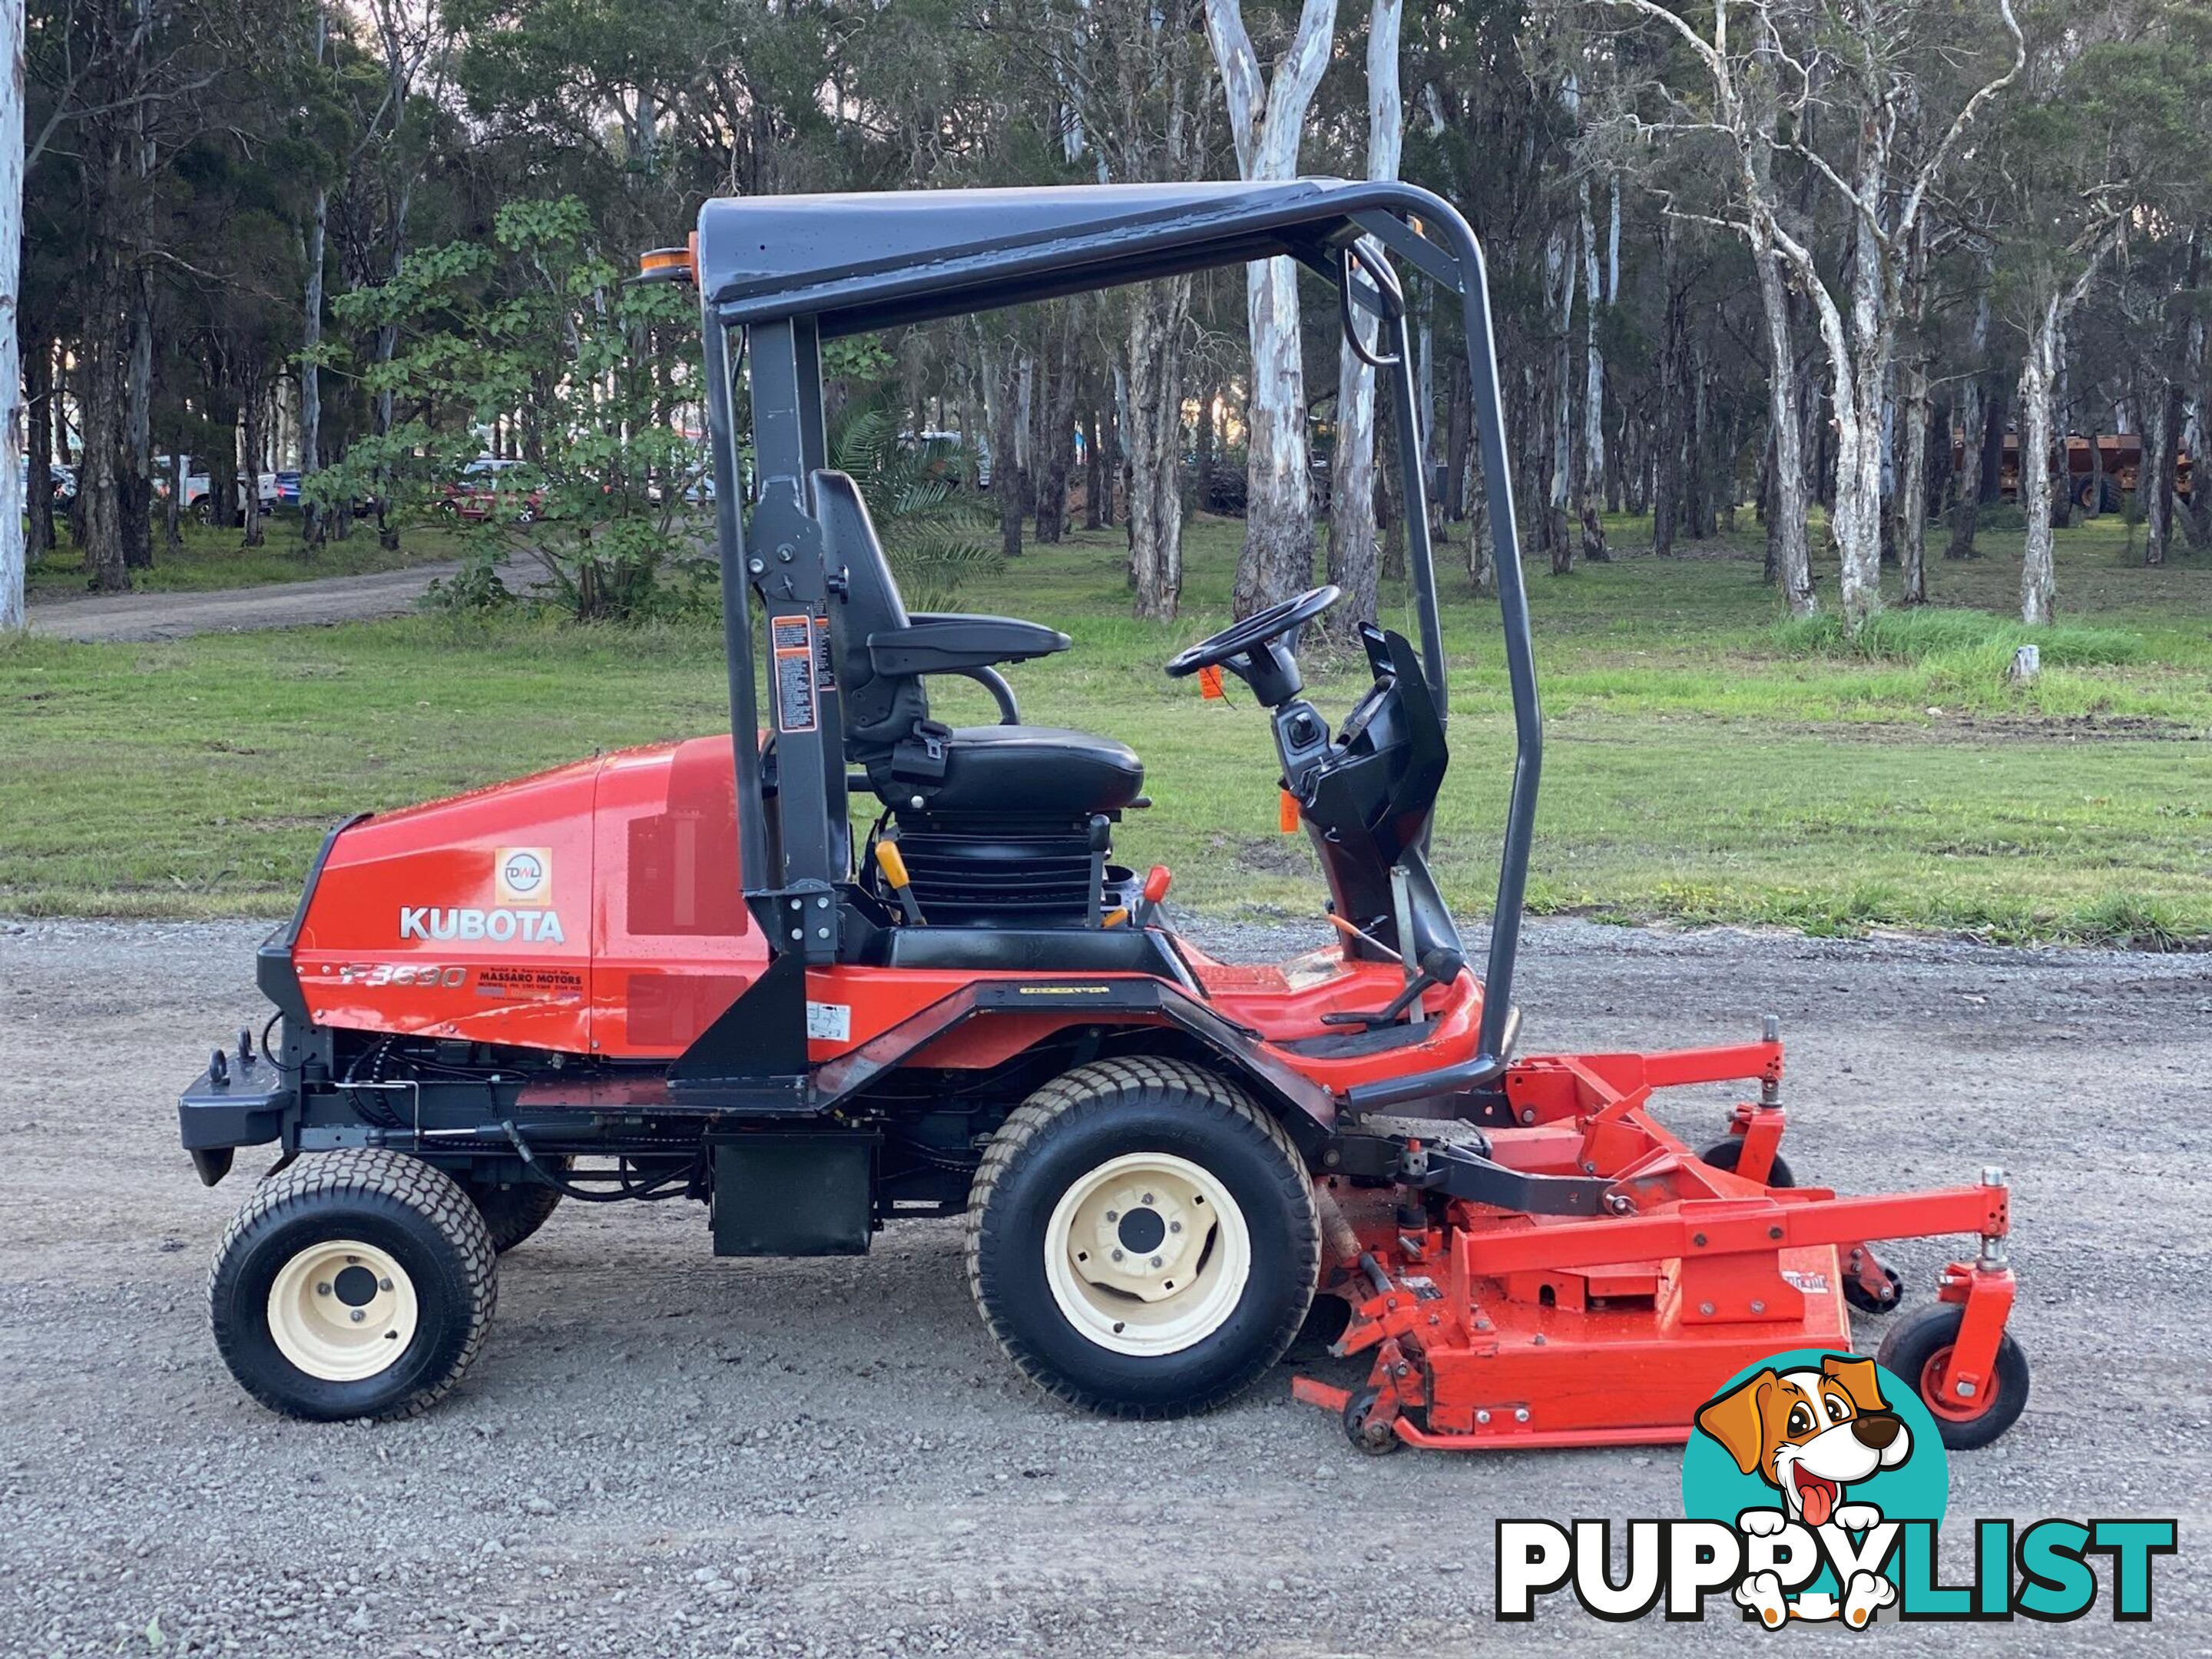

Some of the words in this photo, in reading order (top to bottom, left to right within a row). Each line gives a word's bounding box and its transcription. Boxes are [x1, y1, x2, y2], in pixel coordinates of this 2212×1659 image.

[400, 906, 565, 942] KUBOTA
[343, 963, 467, 988] F3690
[479, 972, 533, 982] MASSARO
[536, 974, 581, 985] MOTORS
